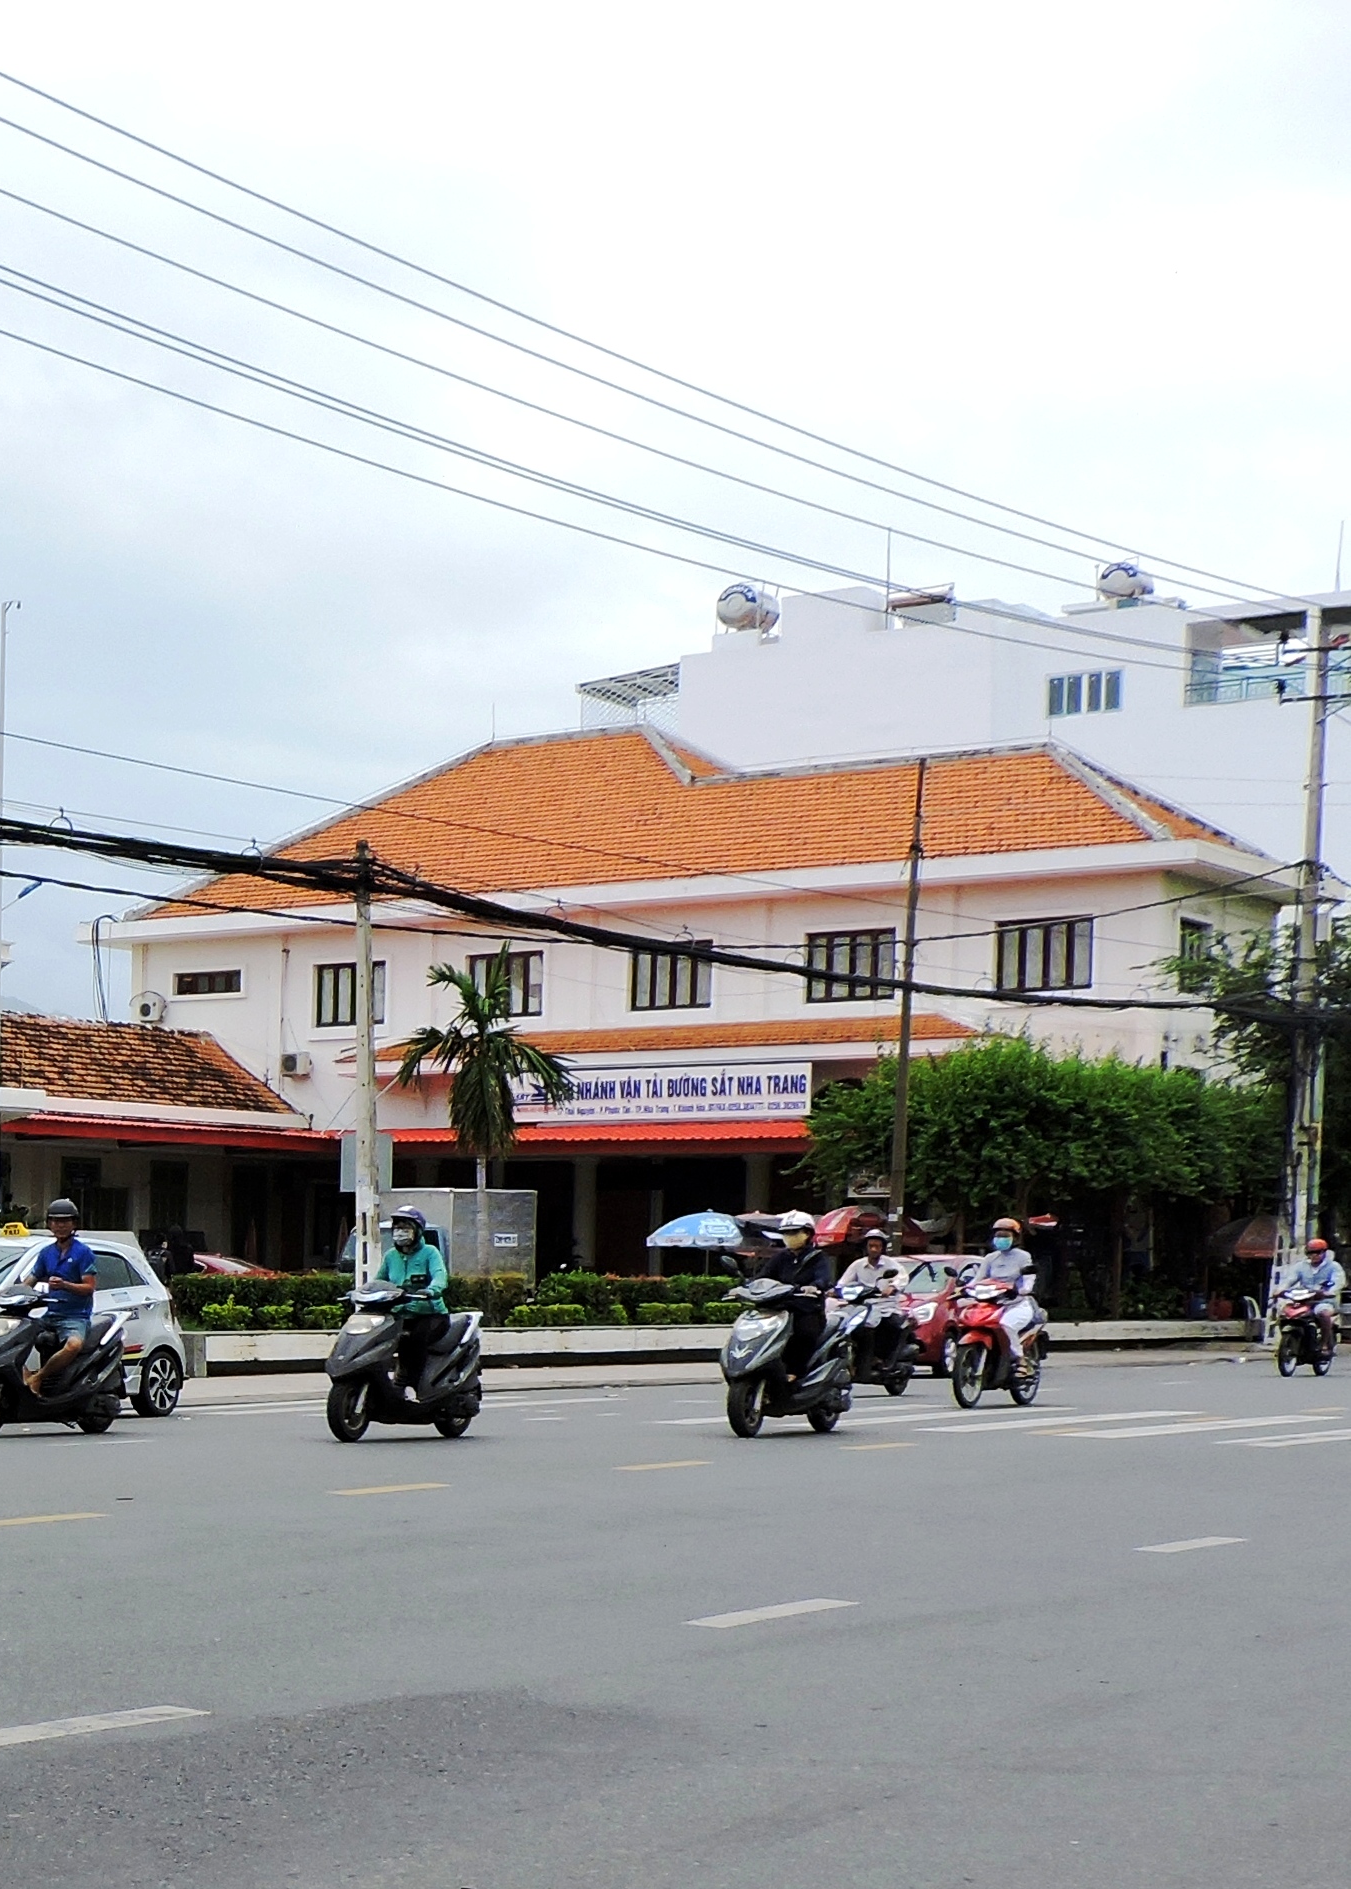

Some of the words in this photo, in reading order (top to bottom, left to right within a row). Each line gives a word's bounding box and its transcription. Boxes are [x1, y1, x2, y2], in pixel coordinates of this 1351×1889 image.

[646, 1072, 663, 1098] TẢI
[711, 1069, 734, 1097] SẮT
[737, 1076, 762, 1096] NHA
[767, 1073, 807, 1095] TRANG
